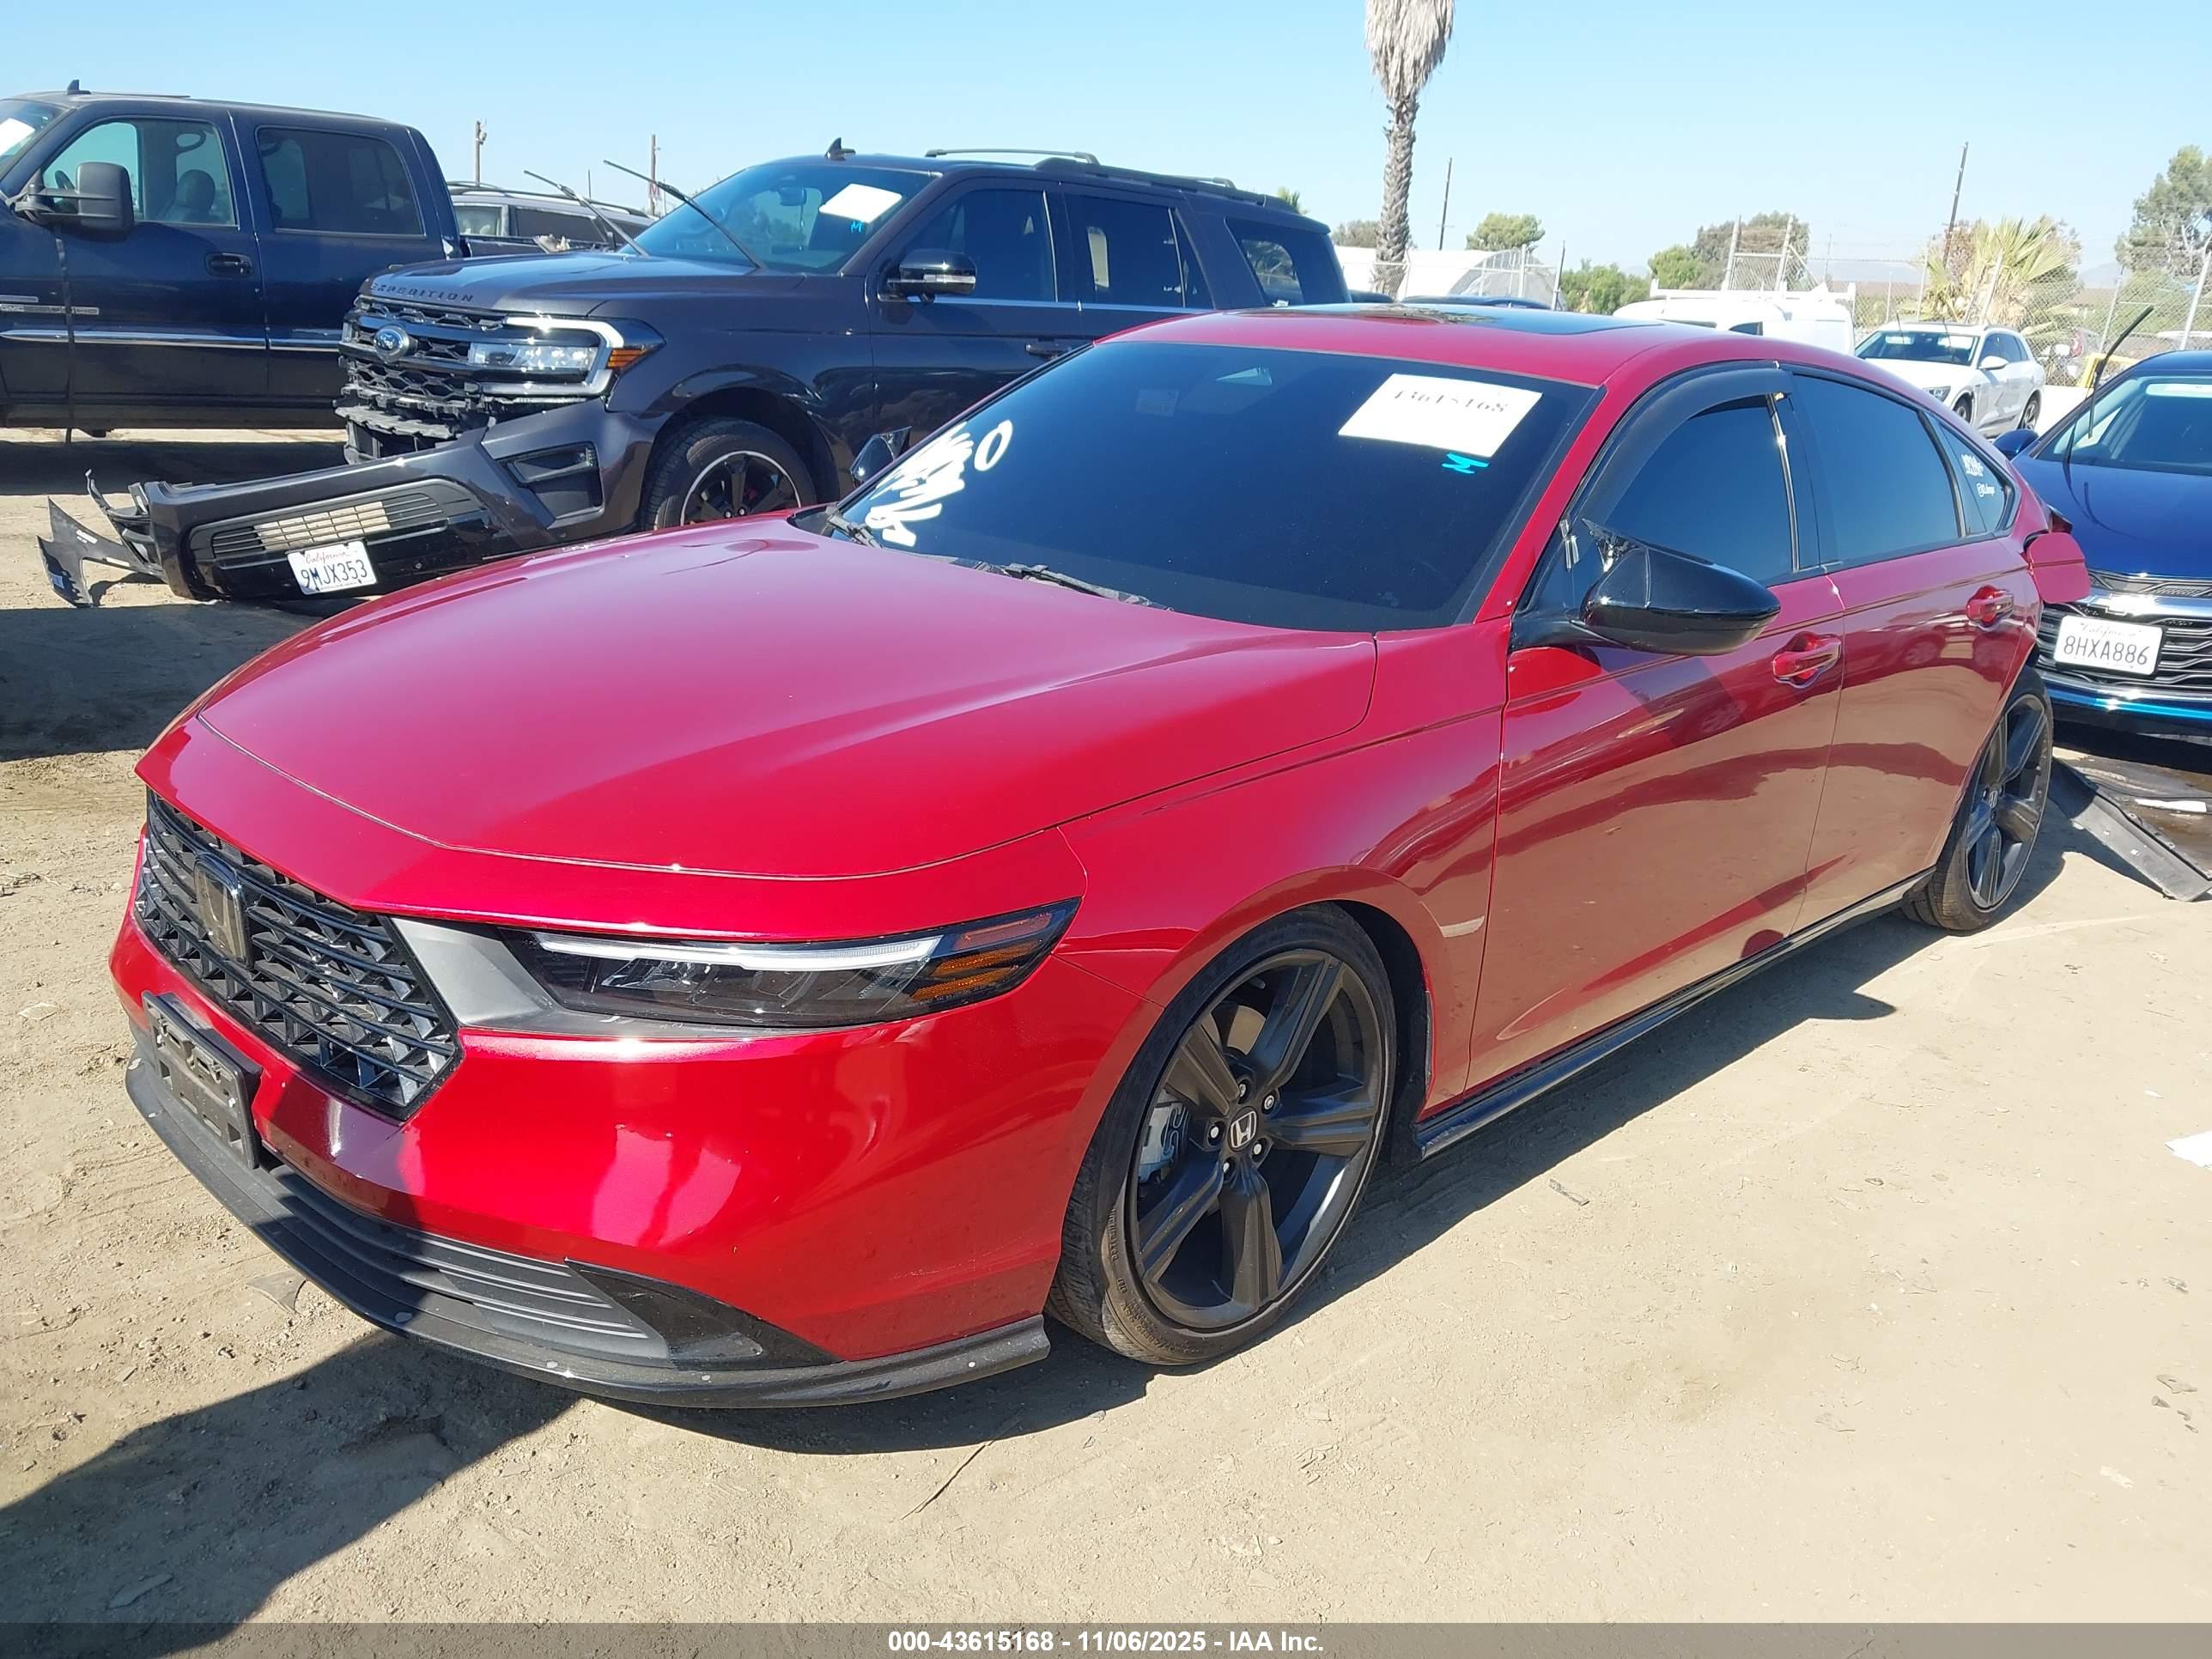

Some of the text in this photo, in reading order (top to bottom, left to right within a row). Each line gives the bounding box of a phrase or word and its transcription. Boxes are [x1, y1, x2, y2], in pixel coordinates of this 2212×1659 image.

[370, 283, 474, 303] EXPEDITION
[306, 550, 351, 564] California
[301, 559, 368, 588] 9MJX353
[2063, 635, 2151, 665] 8HXA886
